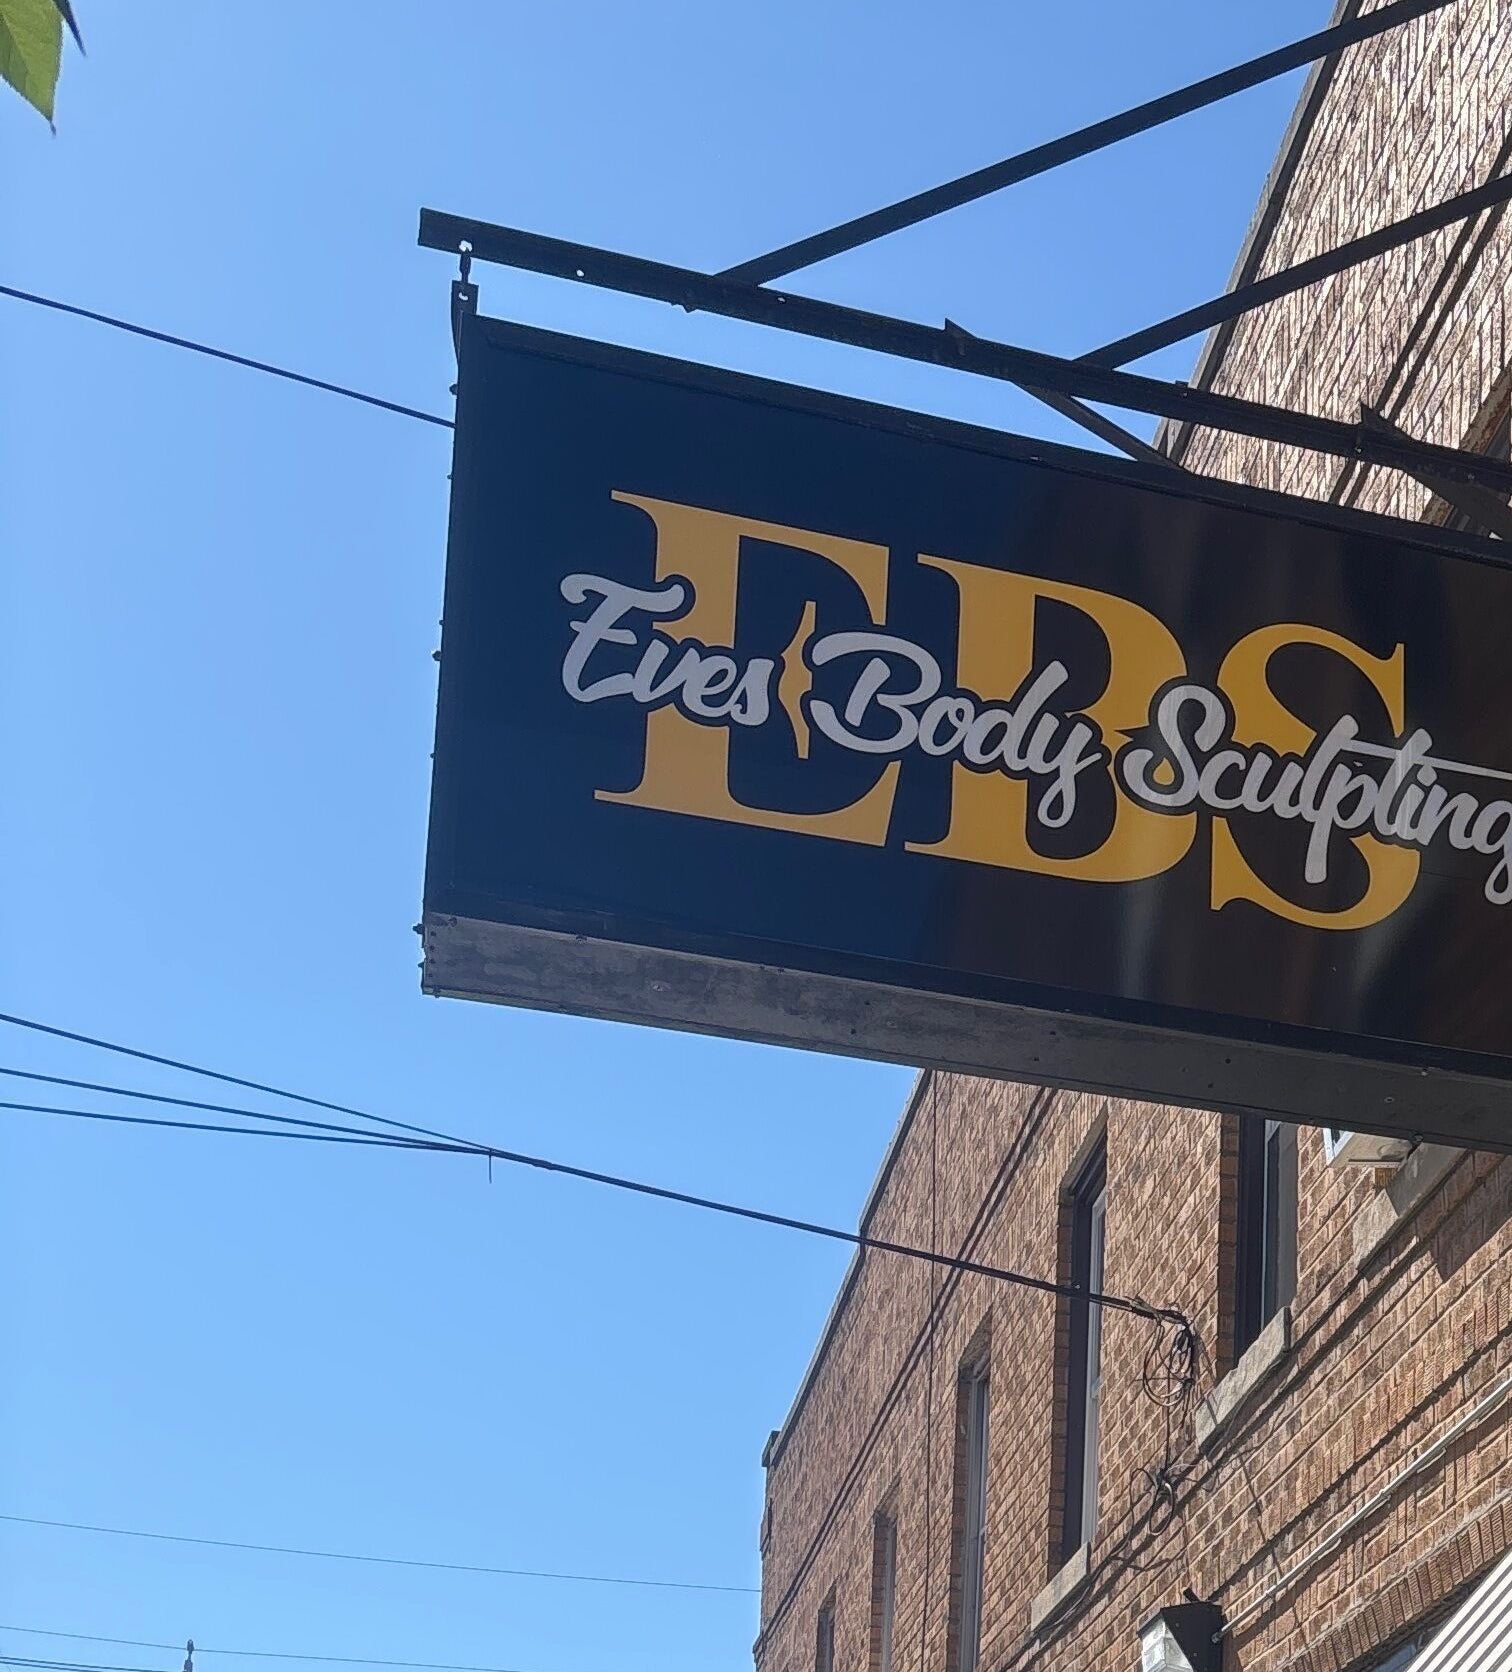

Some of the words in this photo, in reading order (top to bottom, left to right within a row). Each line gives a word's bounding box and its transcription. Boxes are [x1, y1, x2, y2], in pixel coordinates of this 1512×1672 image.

[559, 573, 771, 726] Eves
[811, 631, 1102, 828] Body
[594, 489, 1421, 931] EBS
